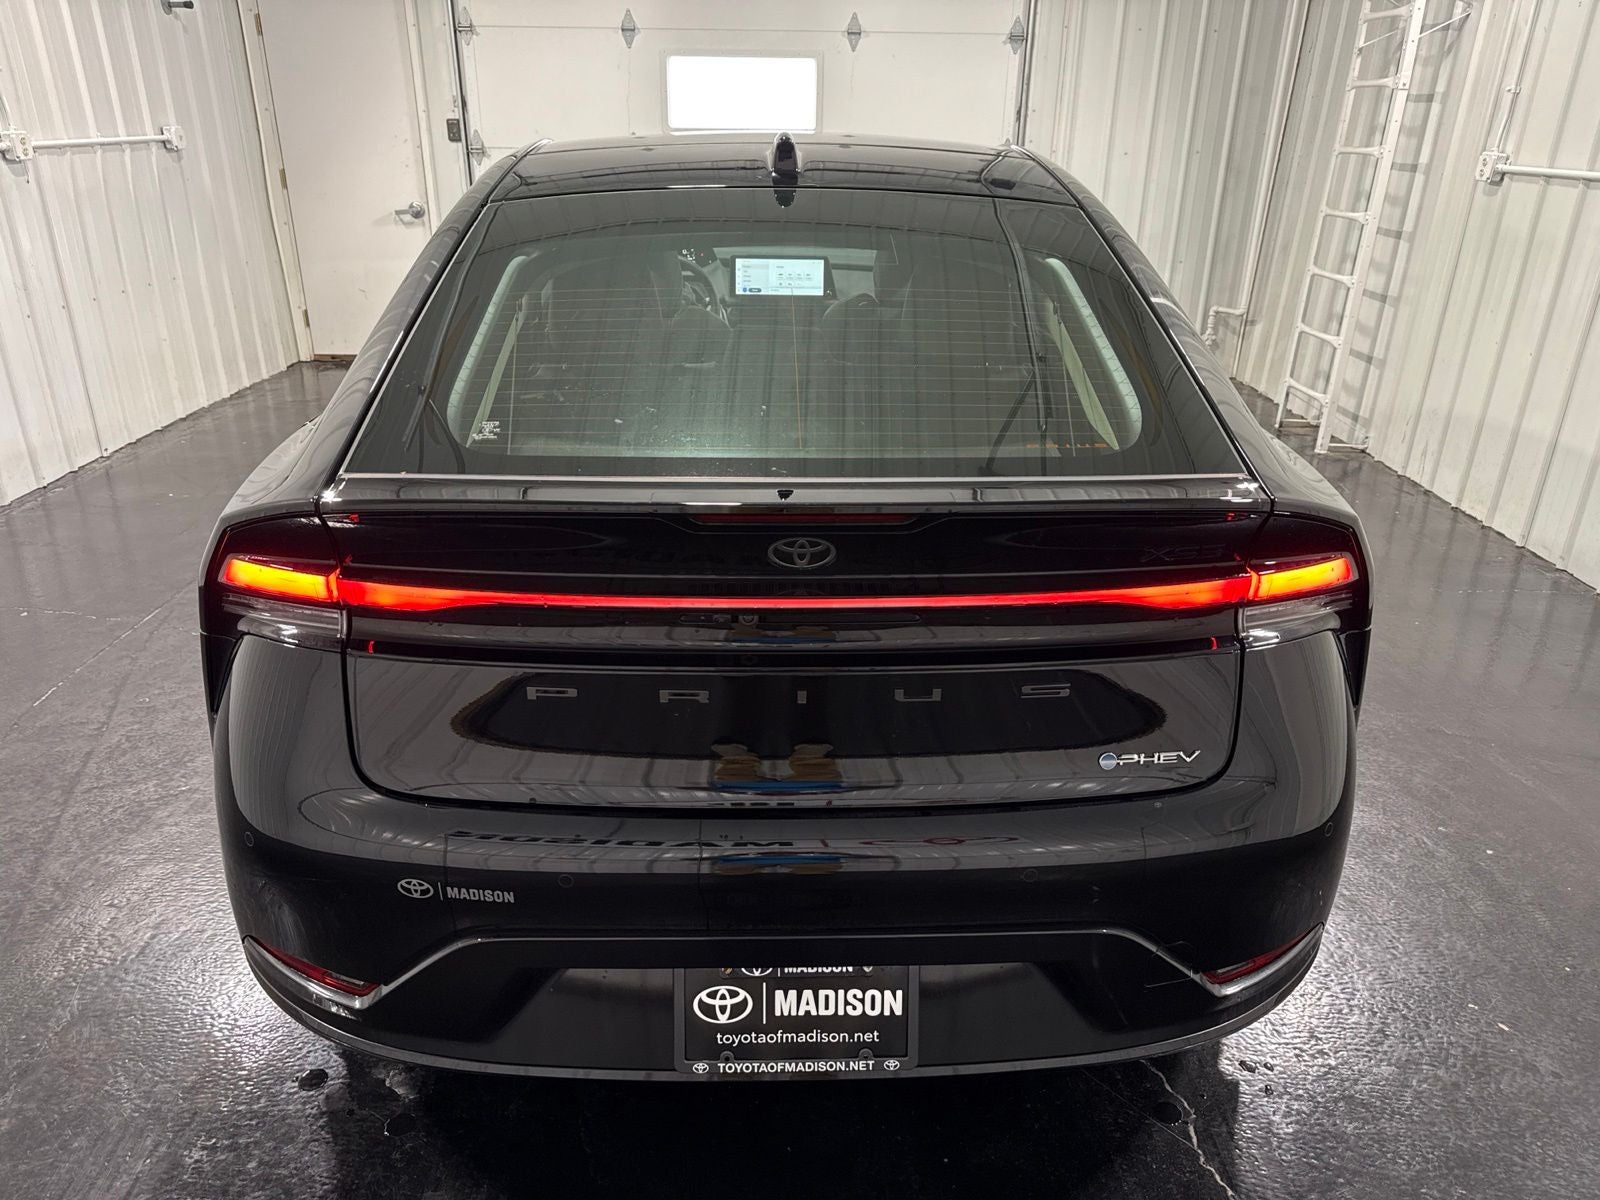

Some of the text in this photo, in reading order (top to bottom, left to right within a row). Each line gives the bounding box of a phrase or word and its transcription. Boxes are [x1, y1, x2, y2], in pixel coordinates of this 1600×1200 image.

[526, 683, 1072, 703] PRIUS
[1117, 750, 1201, 766] PHEV
[446, 886, 515, 903] MADISON
[774, 988, 903, 1017] MADISON
[716, 1029, 880, 1047] toyotaofmadison.net
[717, 1060, 875, 1074] TOYOTAOFMADISON.NET
